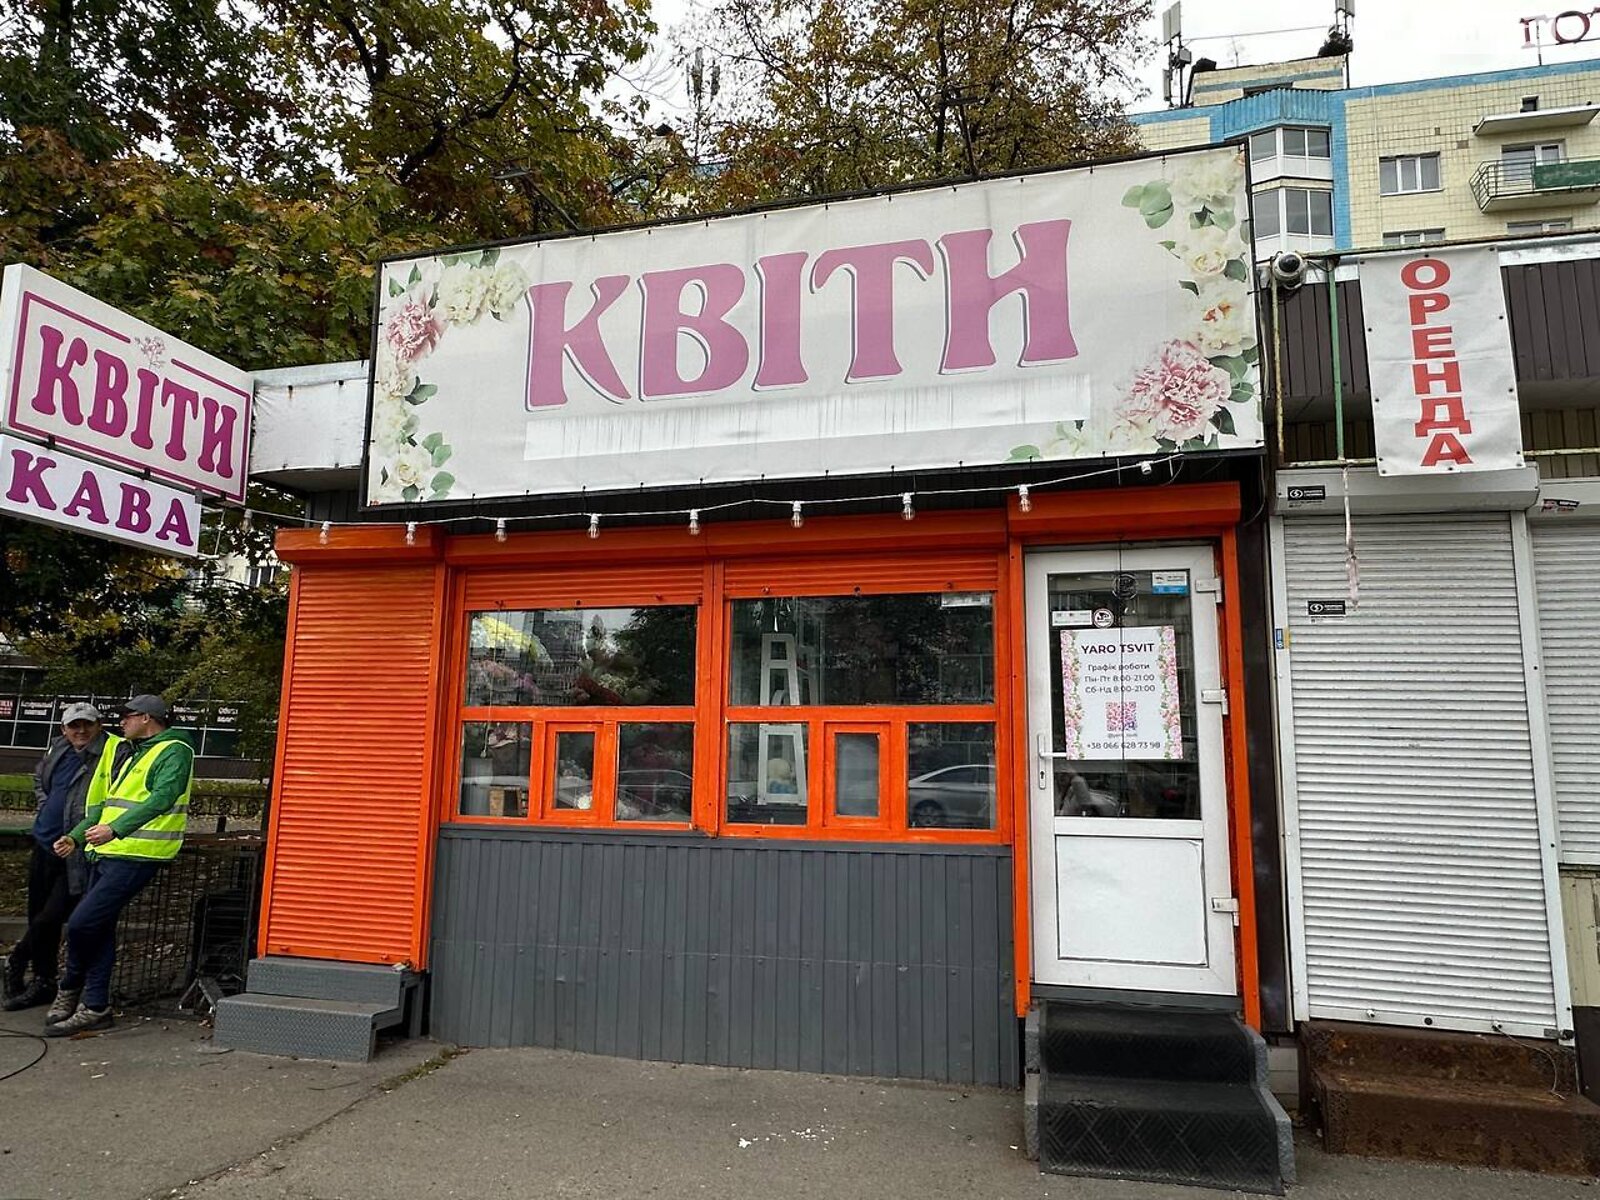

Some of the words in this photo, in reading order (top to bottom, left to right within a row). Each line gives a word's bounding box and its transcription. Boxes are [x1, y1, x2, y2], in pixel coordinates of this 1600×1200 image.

[1519, 7, 1600, 48] ГО
[525, 219, 1079, 412] КВІТИ
[1401, 258, 1473, 466] ОРЕНДА
[31, 324, 238, 479] КВІТИ
[6, 449, 194, 547] КАВА
[1081, 644, 1116, 655] YARO
[1119, 643, 1155, 653] TSVIT
[1088, 663, 1117, 672] Графік
[1118, 662, 1150, 671] роботи
[1086, 742, 1101, 750] +38
